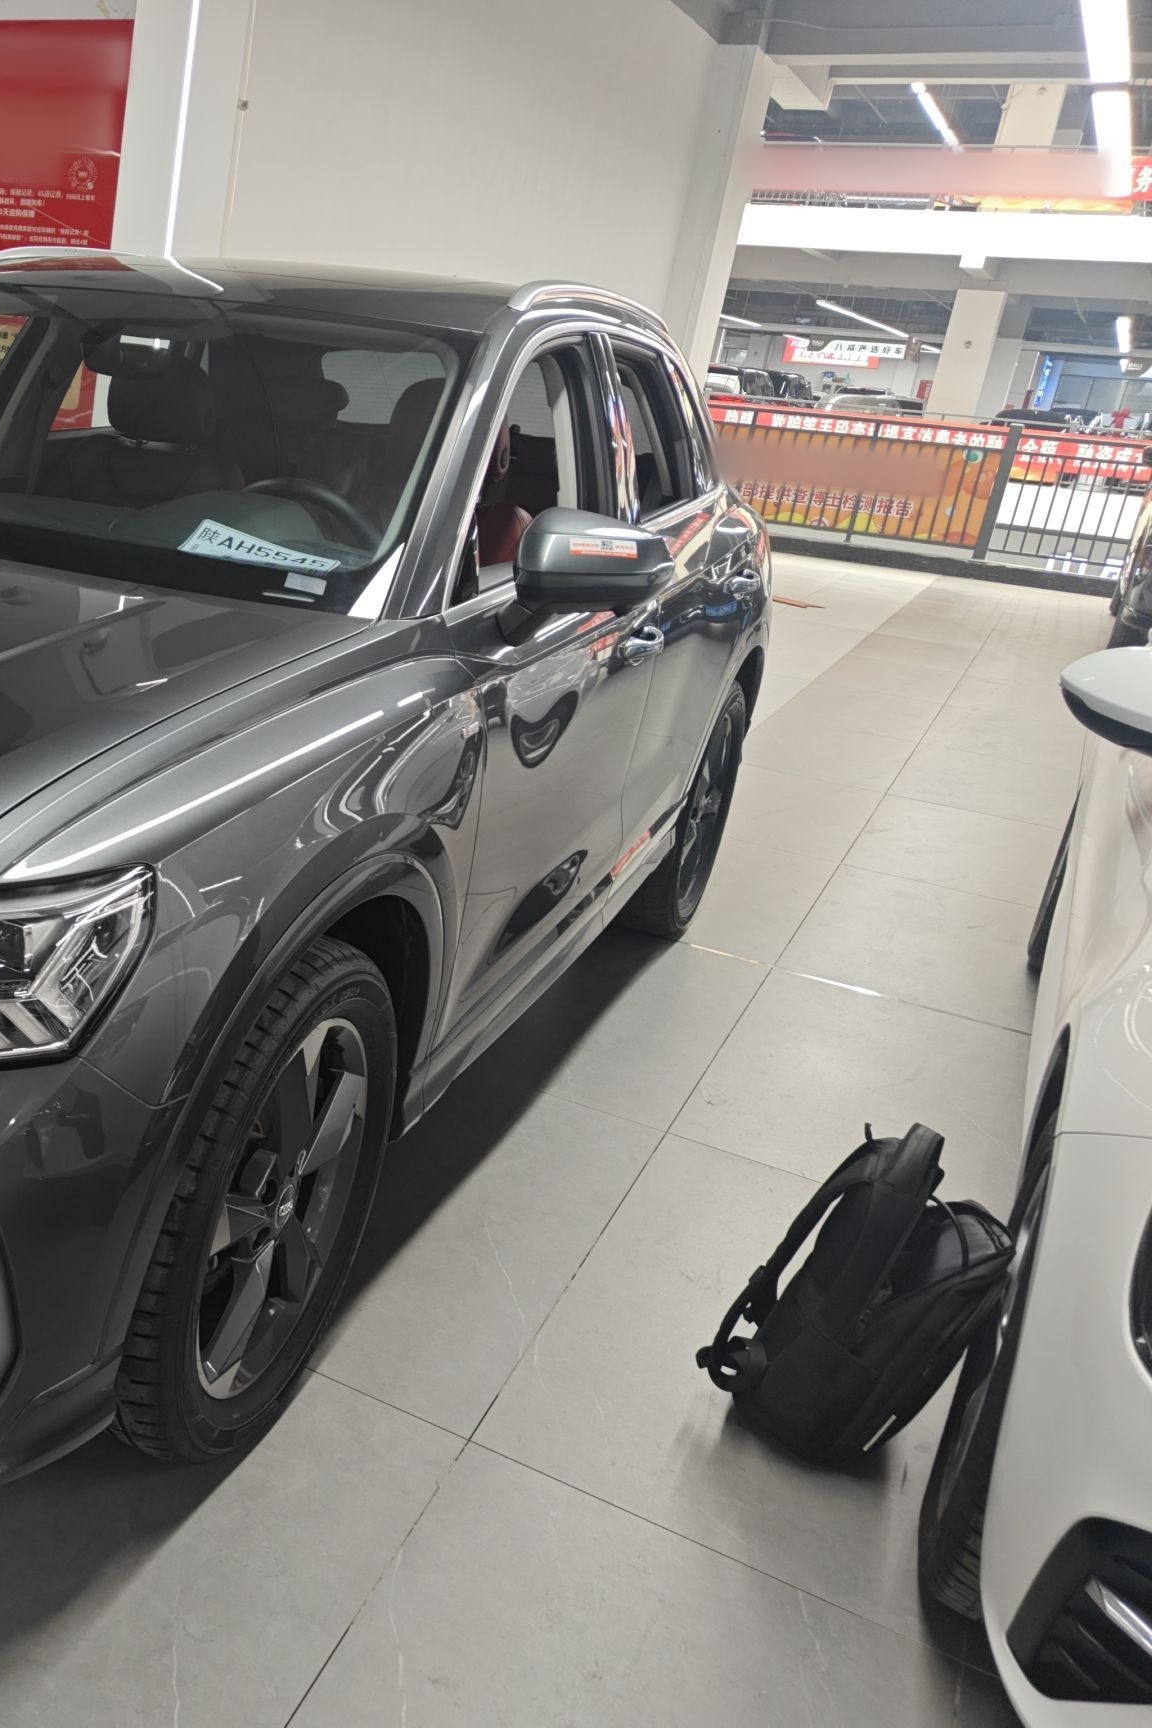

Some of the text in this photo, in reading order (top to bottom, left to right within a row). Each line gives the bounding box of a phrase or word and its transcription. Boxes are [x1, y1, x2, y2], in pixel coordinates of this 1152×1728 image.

[731, 480, 914, 518] 部提供查博士检测报告
[197, 526, 328, 568] 陕AH5545
